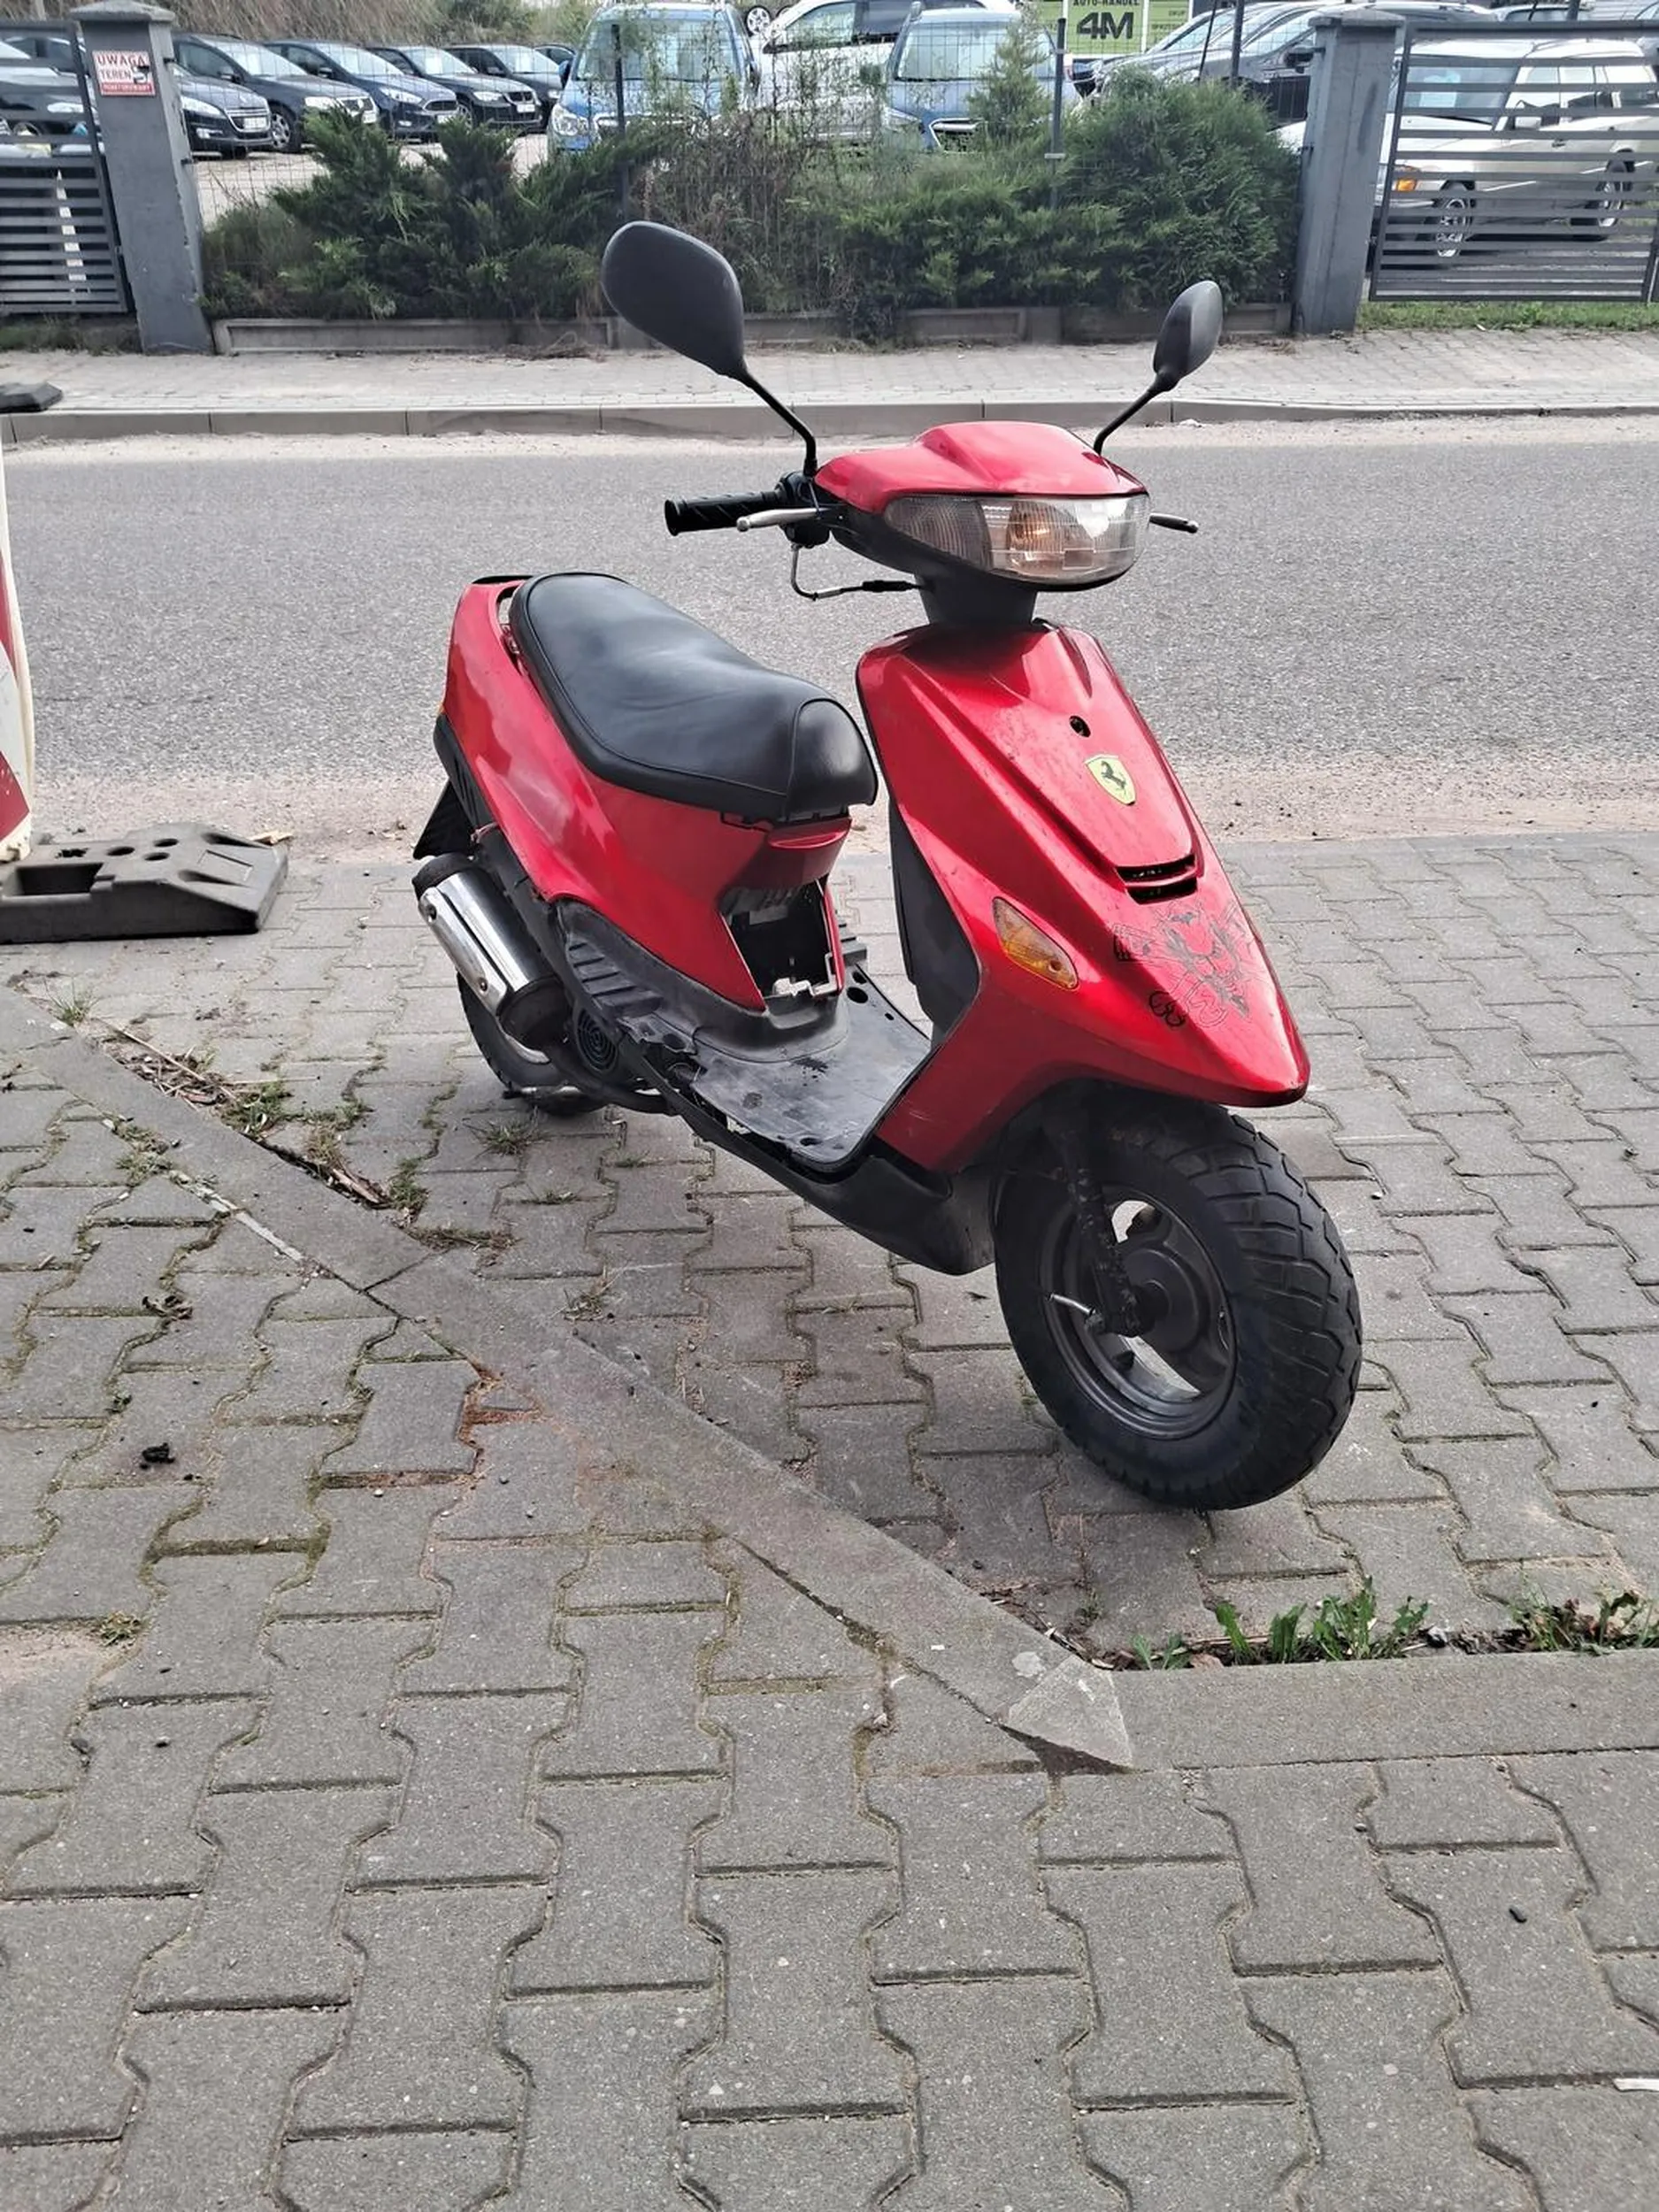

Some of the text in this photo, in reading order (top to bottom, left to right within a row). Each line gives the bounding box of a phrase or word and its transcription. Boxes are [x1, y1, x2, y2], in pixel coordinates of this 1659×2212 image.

[1077, 12, 1134, 39] 4M
[97, 54, 145, 65] UWAGA
[100, 69, 132, 80] TEREN
